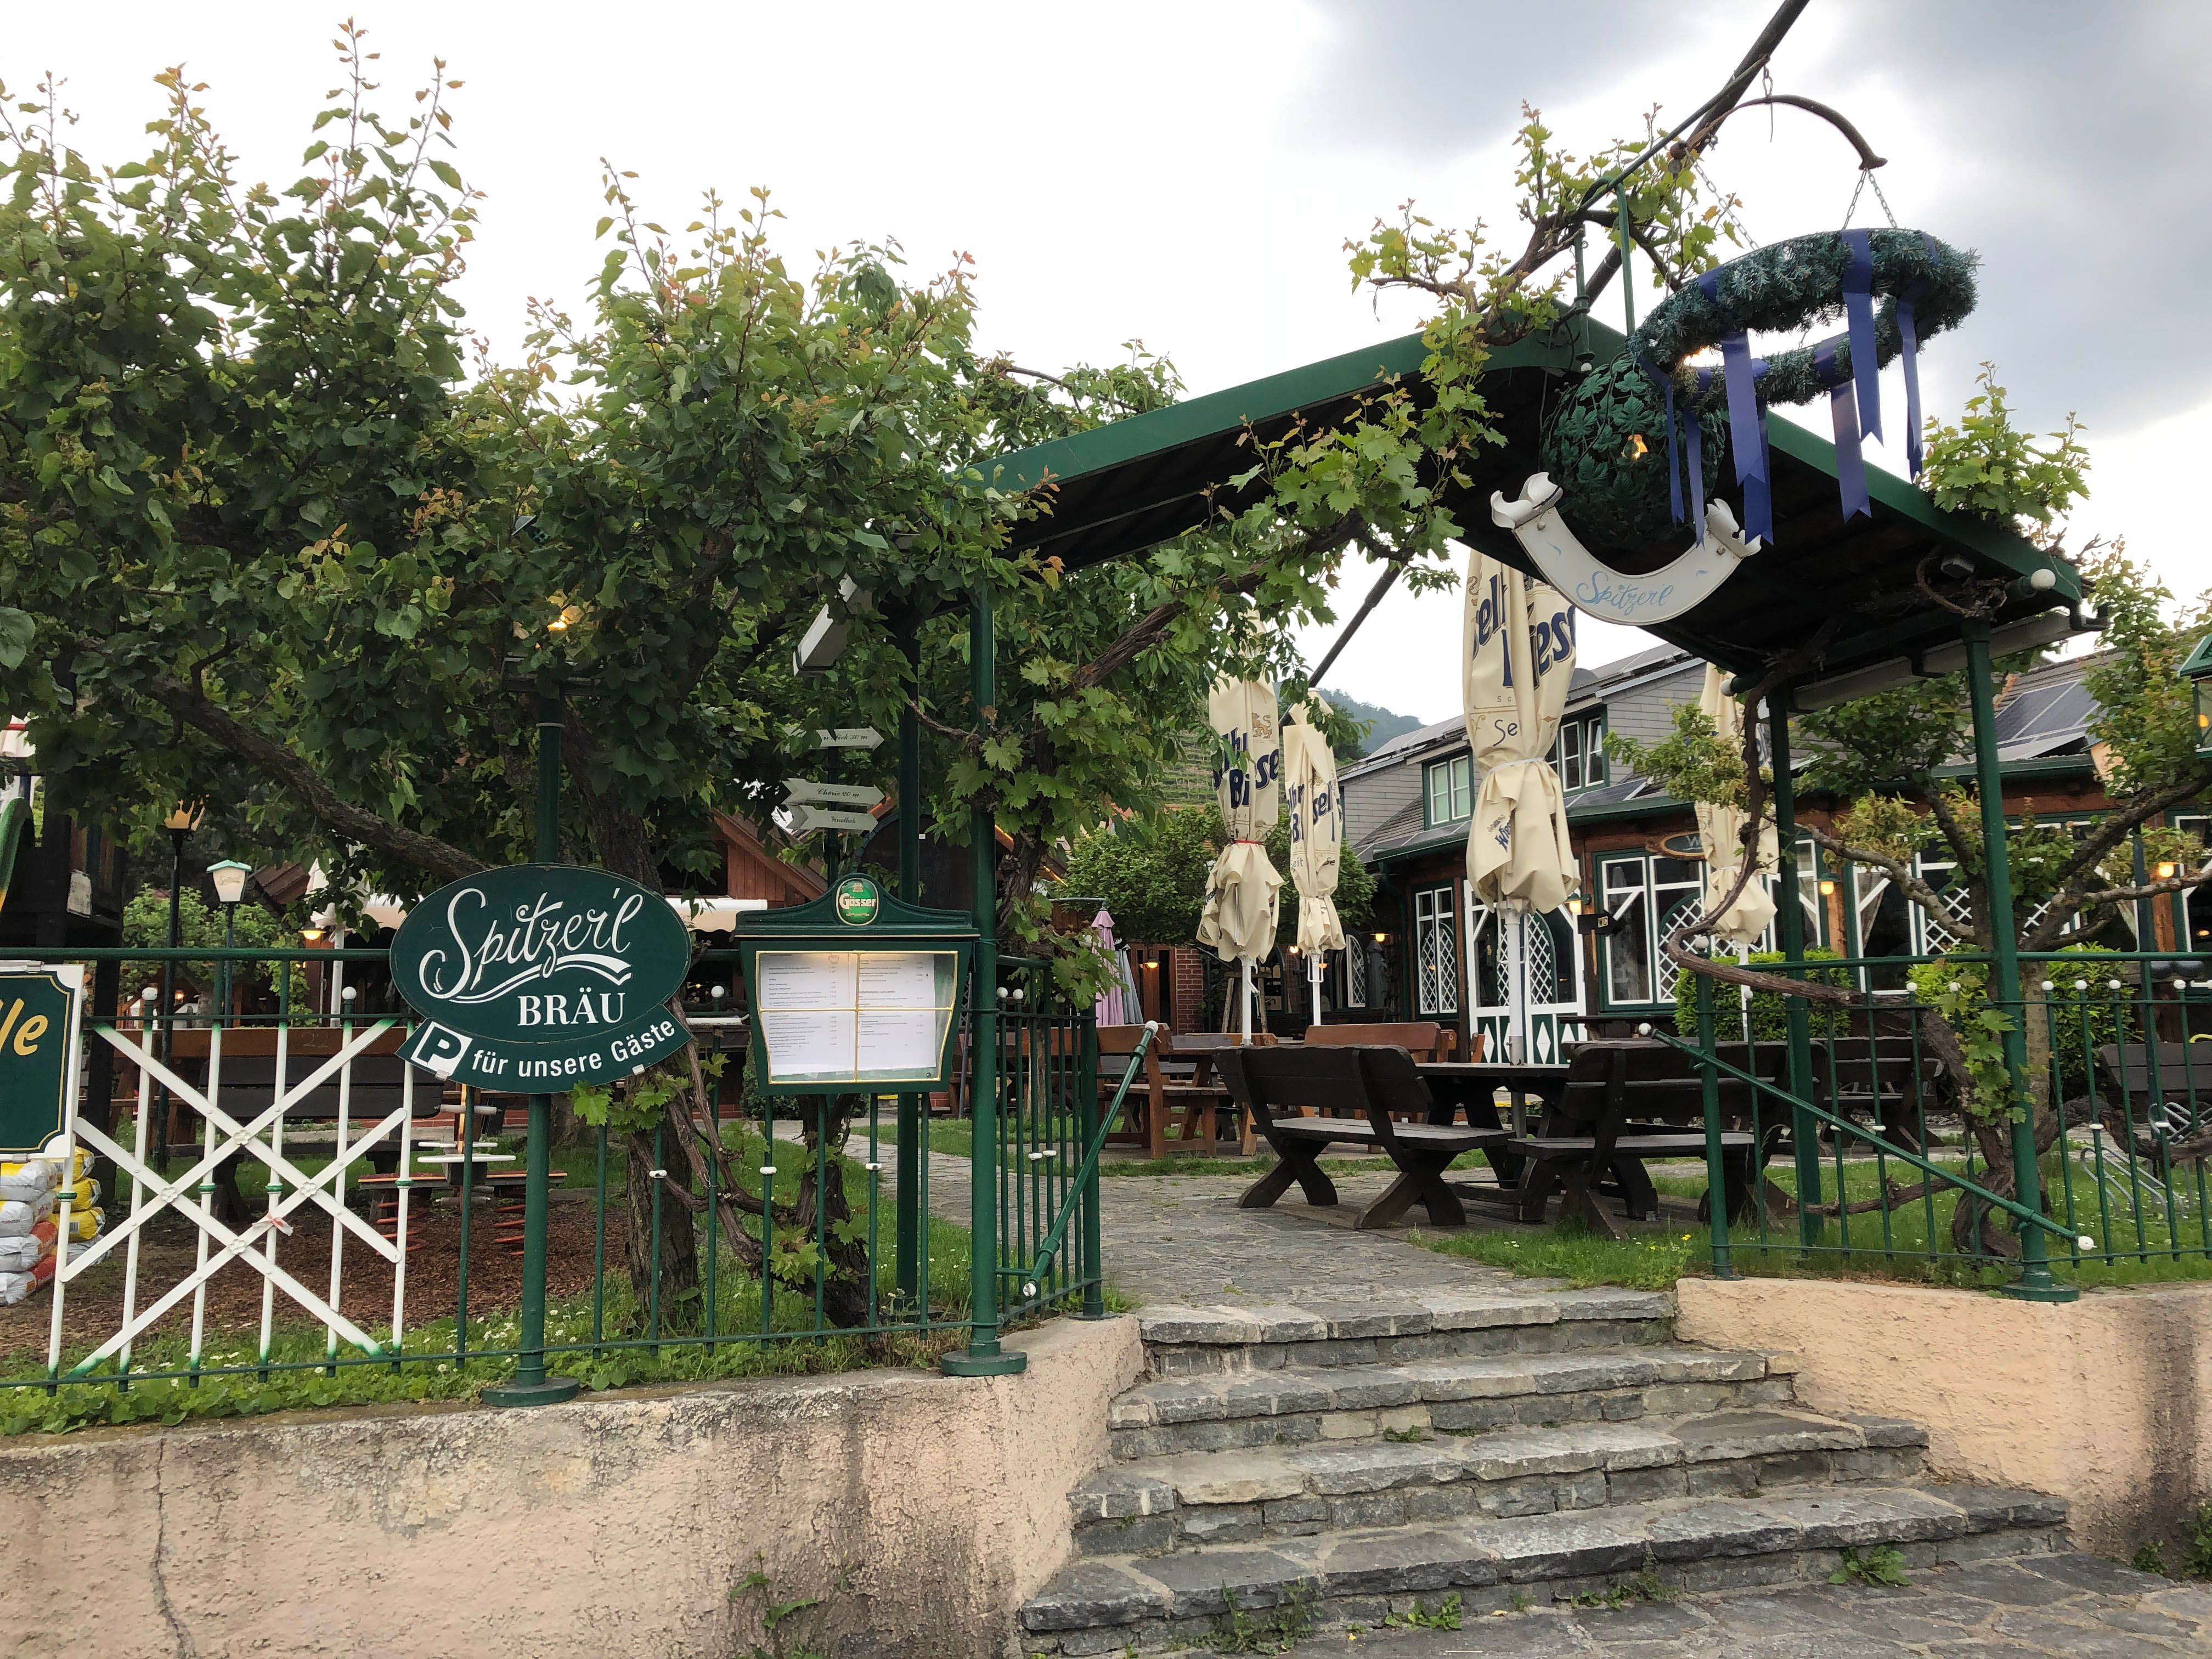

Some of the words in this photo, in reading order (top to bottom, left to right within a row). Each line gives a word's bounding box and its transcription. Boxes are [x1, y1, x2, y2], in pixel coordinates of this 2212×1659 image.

[839, 893, 877, 910] Gösser
[1598, 917, 1607, 926] WC
[517, 987, 625, 1026] BRÄU
[0, 998, 48, 1056] le
[472, 1049, 508, 1075] für
[518, 1052, 602, 1077] unsere
[611, 1019, 675, 1063] Gäste
